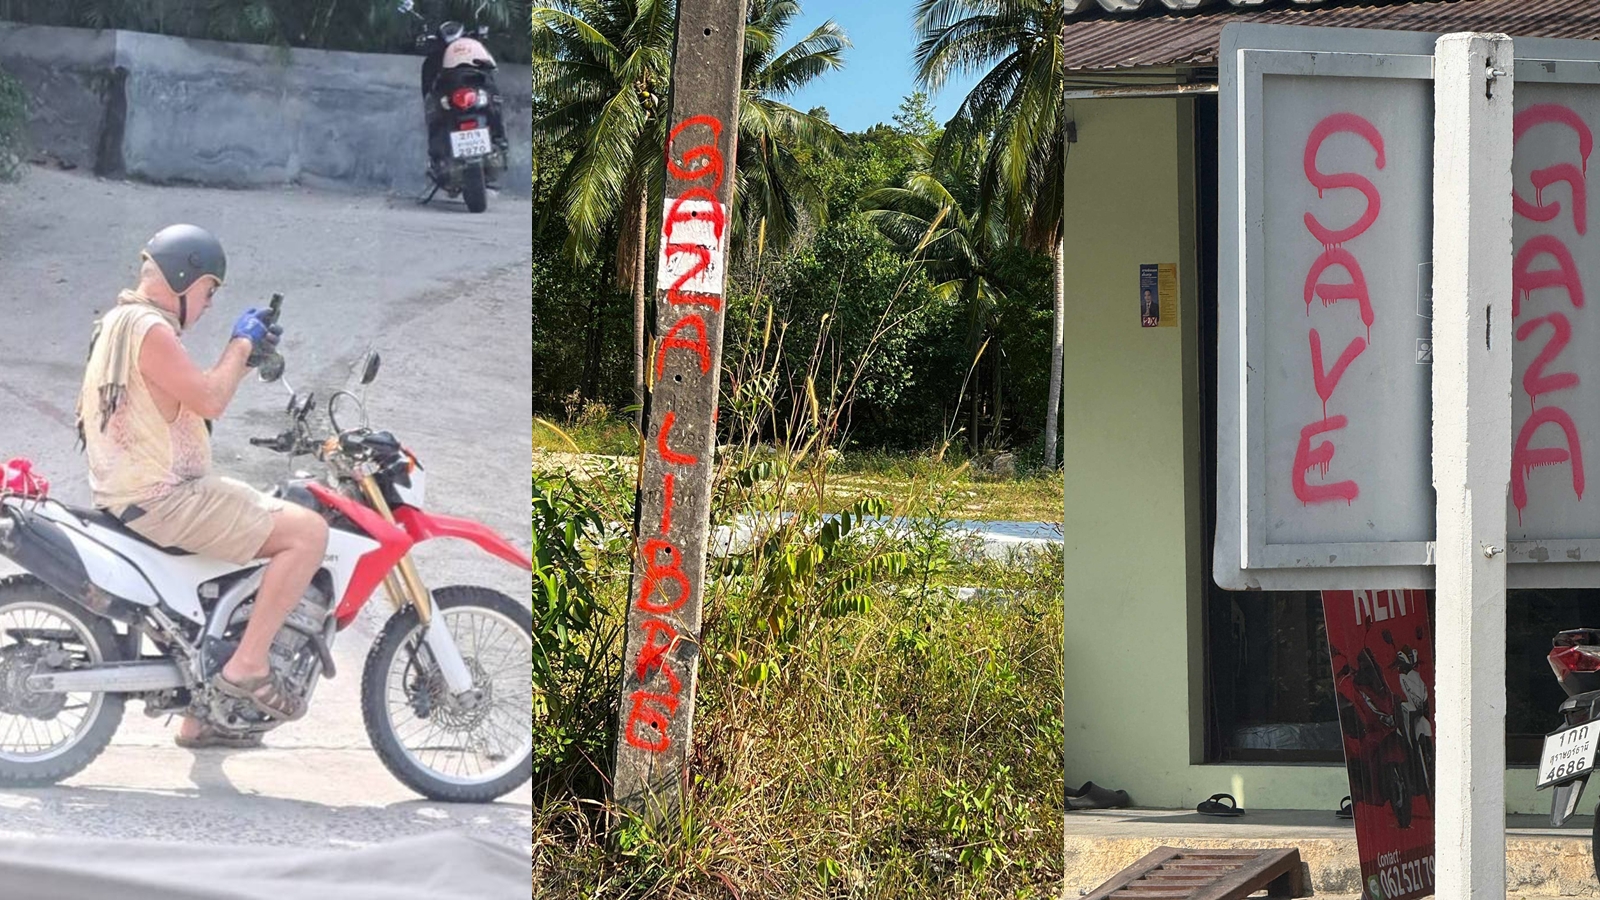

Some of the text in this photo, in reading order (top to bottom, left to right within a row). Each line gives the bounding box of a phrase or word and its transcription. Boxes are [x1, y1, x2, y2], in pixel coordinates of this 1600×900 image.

[656, 114, 726, 382] GAZA
[1291, 111, 1386, 507] SAVE
[1511, 102, 1594, 517] GAZA
[625, 410, 697, 753] LIBRE
[1380, 865, 1406, 899] 062
[1401, 859, 1424, 893] 527
[1546, 756, 1586, 781] 4686
